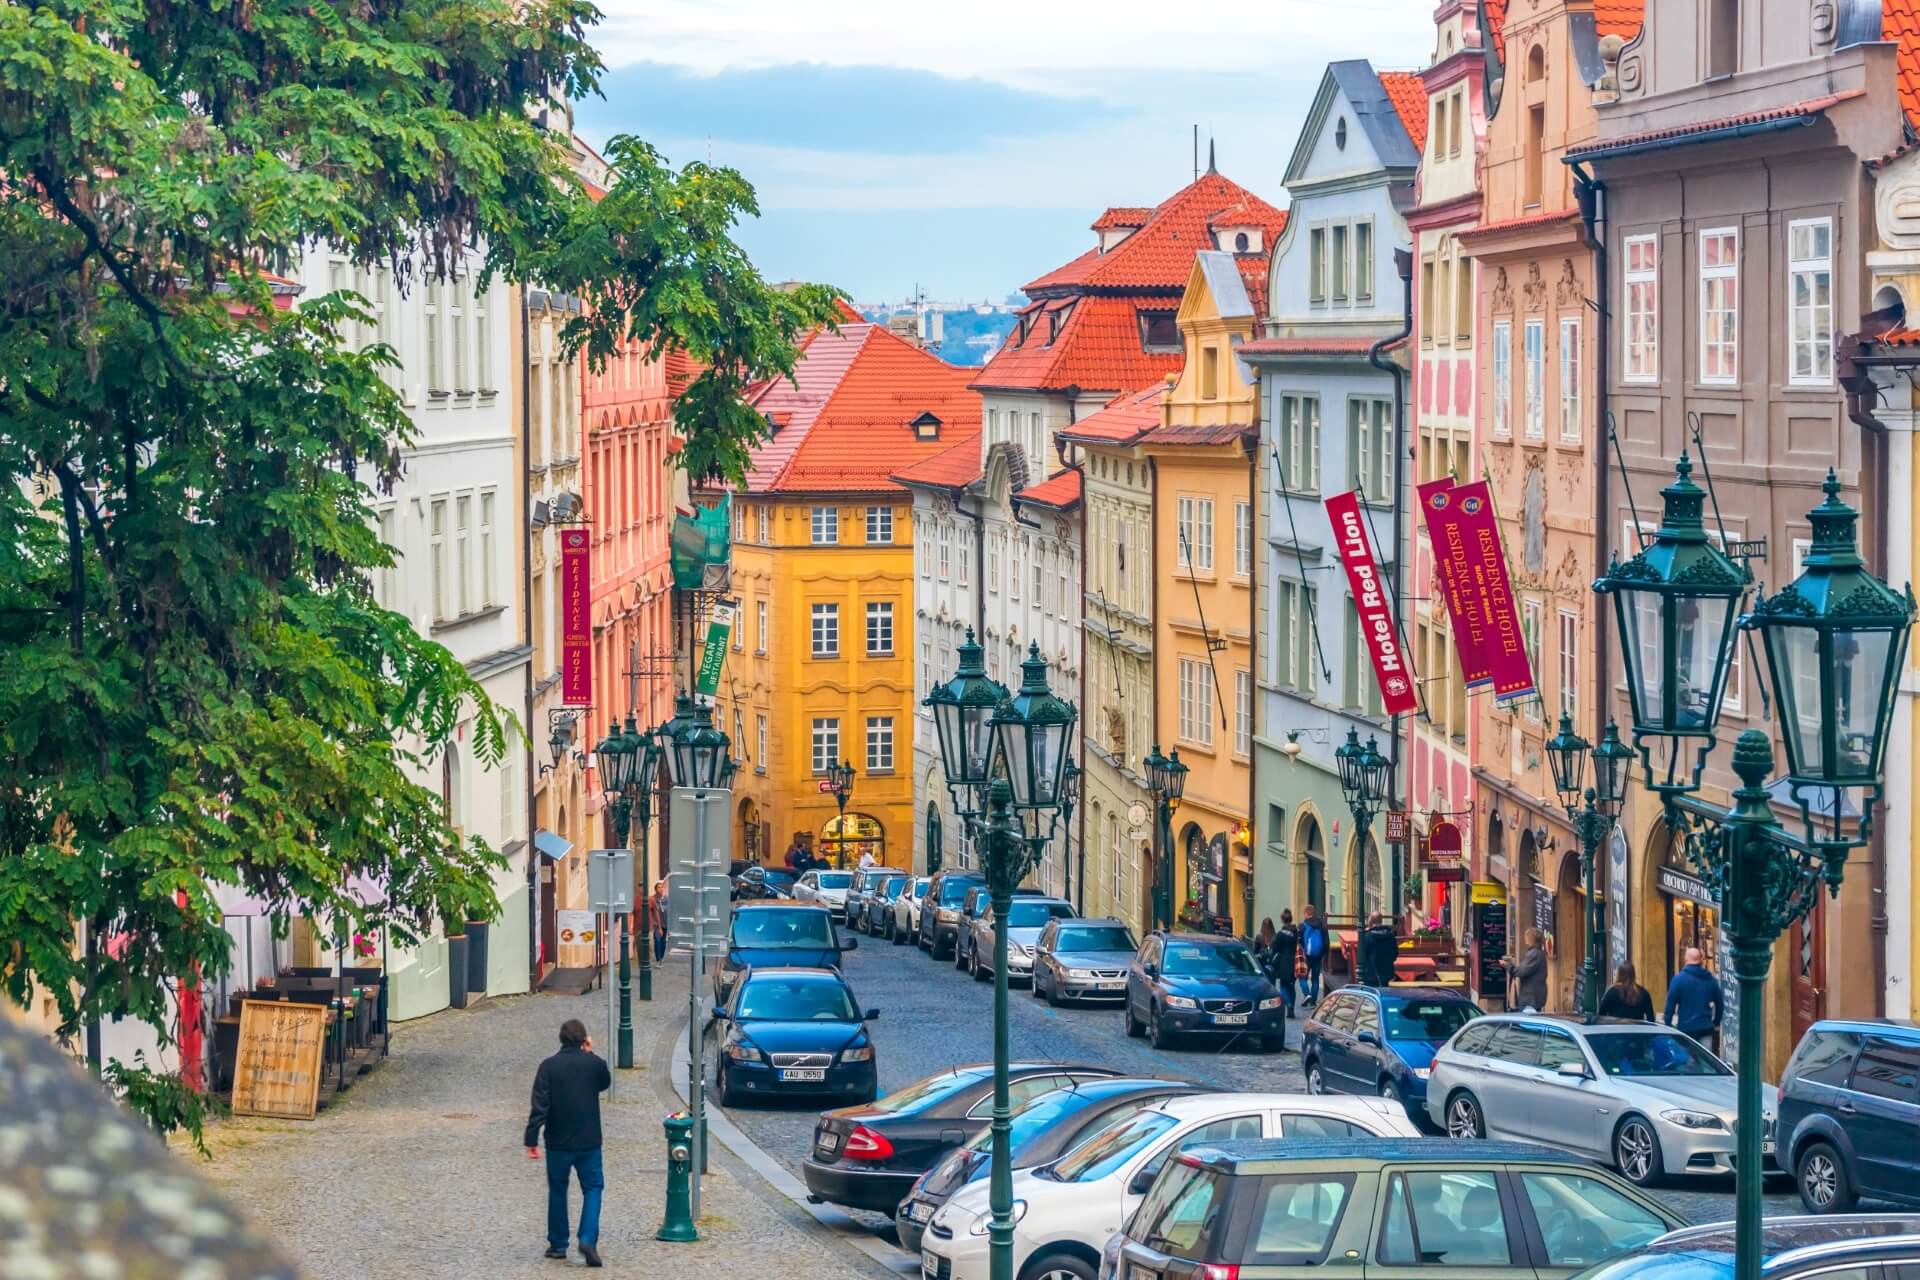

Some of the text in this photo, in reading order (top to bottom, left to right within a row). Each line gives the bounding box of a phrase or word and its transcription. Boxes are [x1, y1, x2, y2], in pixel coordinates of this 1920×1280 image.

[571, 558, 581, 631] RESIDENCE
[1342, 511, 1400, 672] Hotel Red Lion
[1445, 522, 1485, 646] RESIDENCE HOTEL
[1448, 579, 1456, 591] DE
[1450, 590, 1463, 617] PRAGUE
[1474, 565, 1493, 625] BIJOU DE PRAGUE
[1477, 528, 1518, 657] RESIDENCE HOTEL
[572, 650, 581, 691] HOTEL
[701, 642, 716, 676] VEGAN
[709, 636, 727, 685] RESTAURANT
[1663, 872, 1688, 893] OBCHOD
[784, 1070, 822, 1079] 4AU 0550
